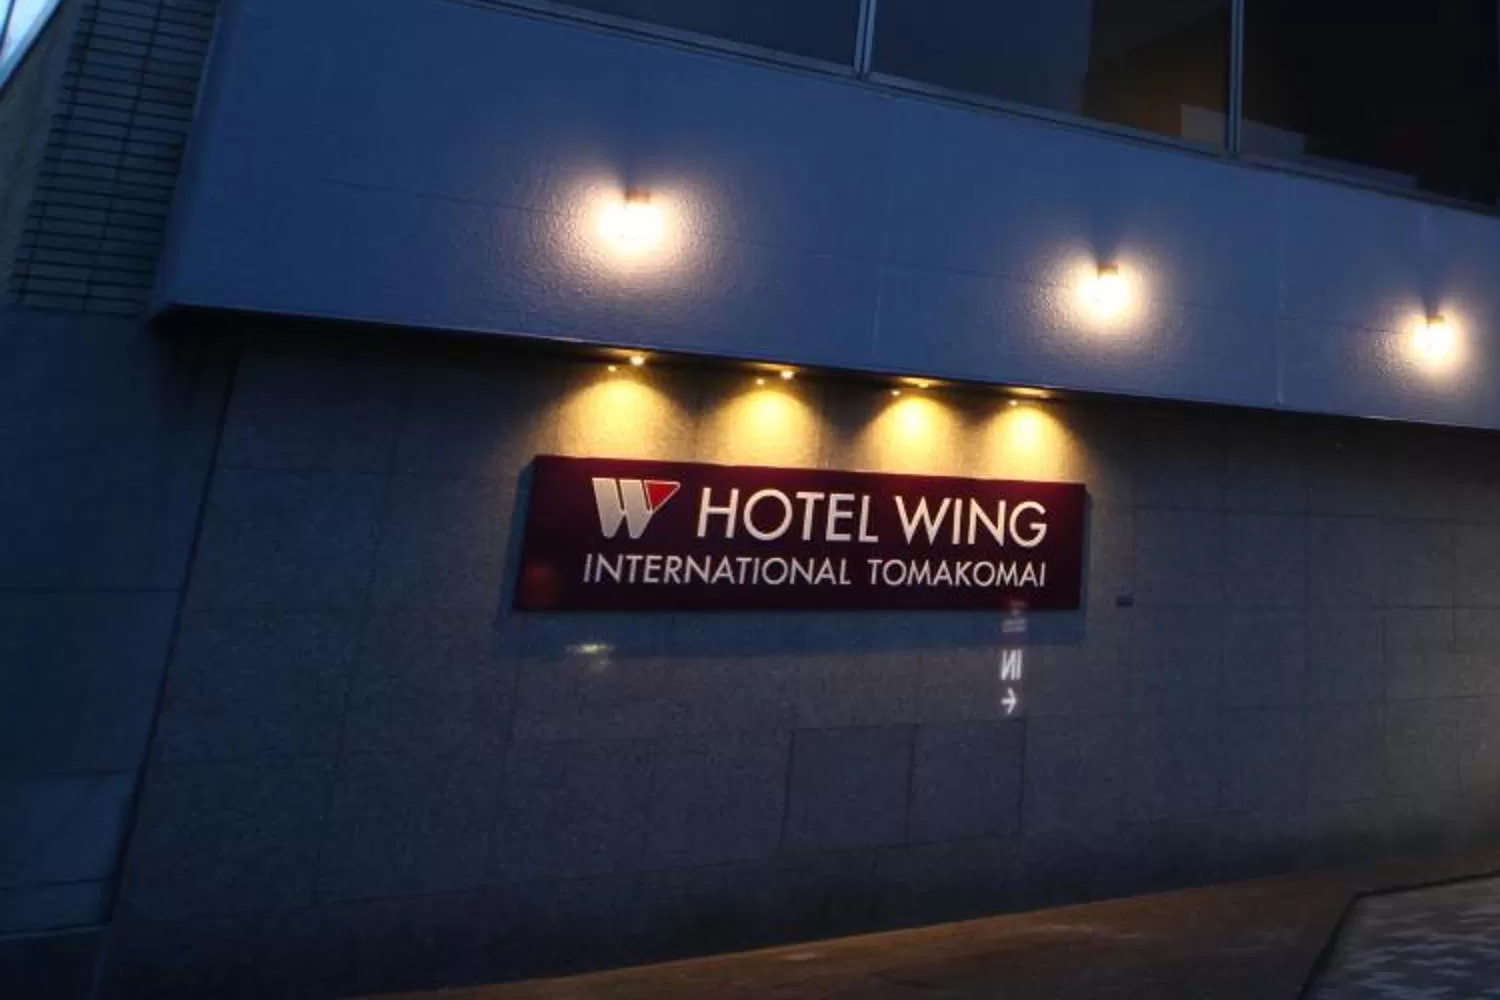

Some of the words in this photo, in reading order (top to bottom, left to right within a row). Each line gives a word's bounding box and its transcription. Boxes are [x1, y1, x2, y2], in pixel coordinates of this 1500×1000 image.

[696, 487, 879, 544] HOTEL
[895, 495, 1048, 547] WING
[583, 553, 852, 586] INTERNATIONAL
[867, 558, 1047, 588] TOMAKOMAI
